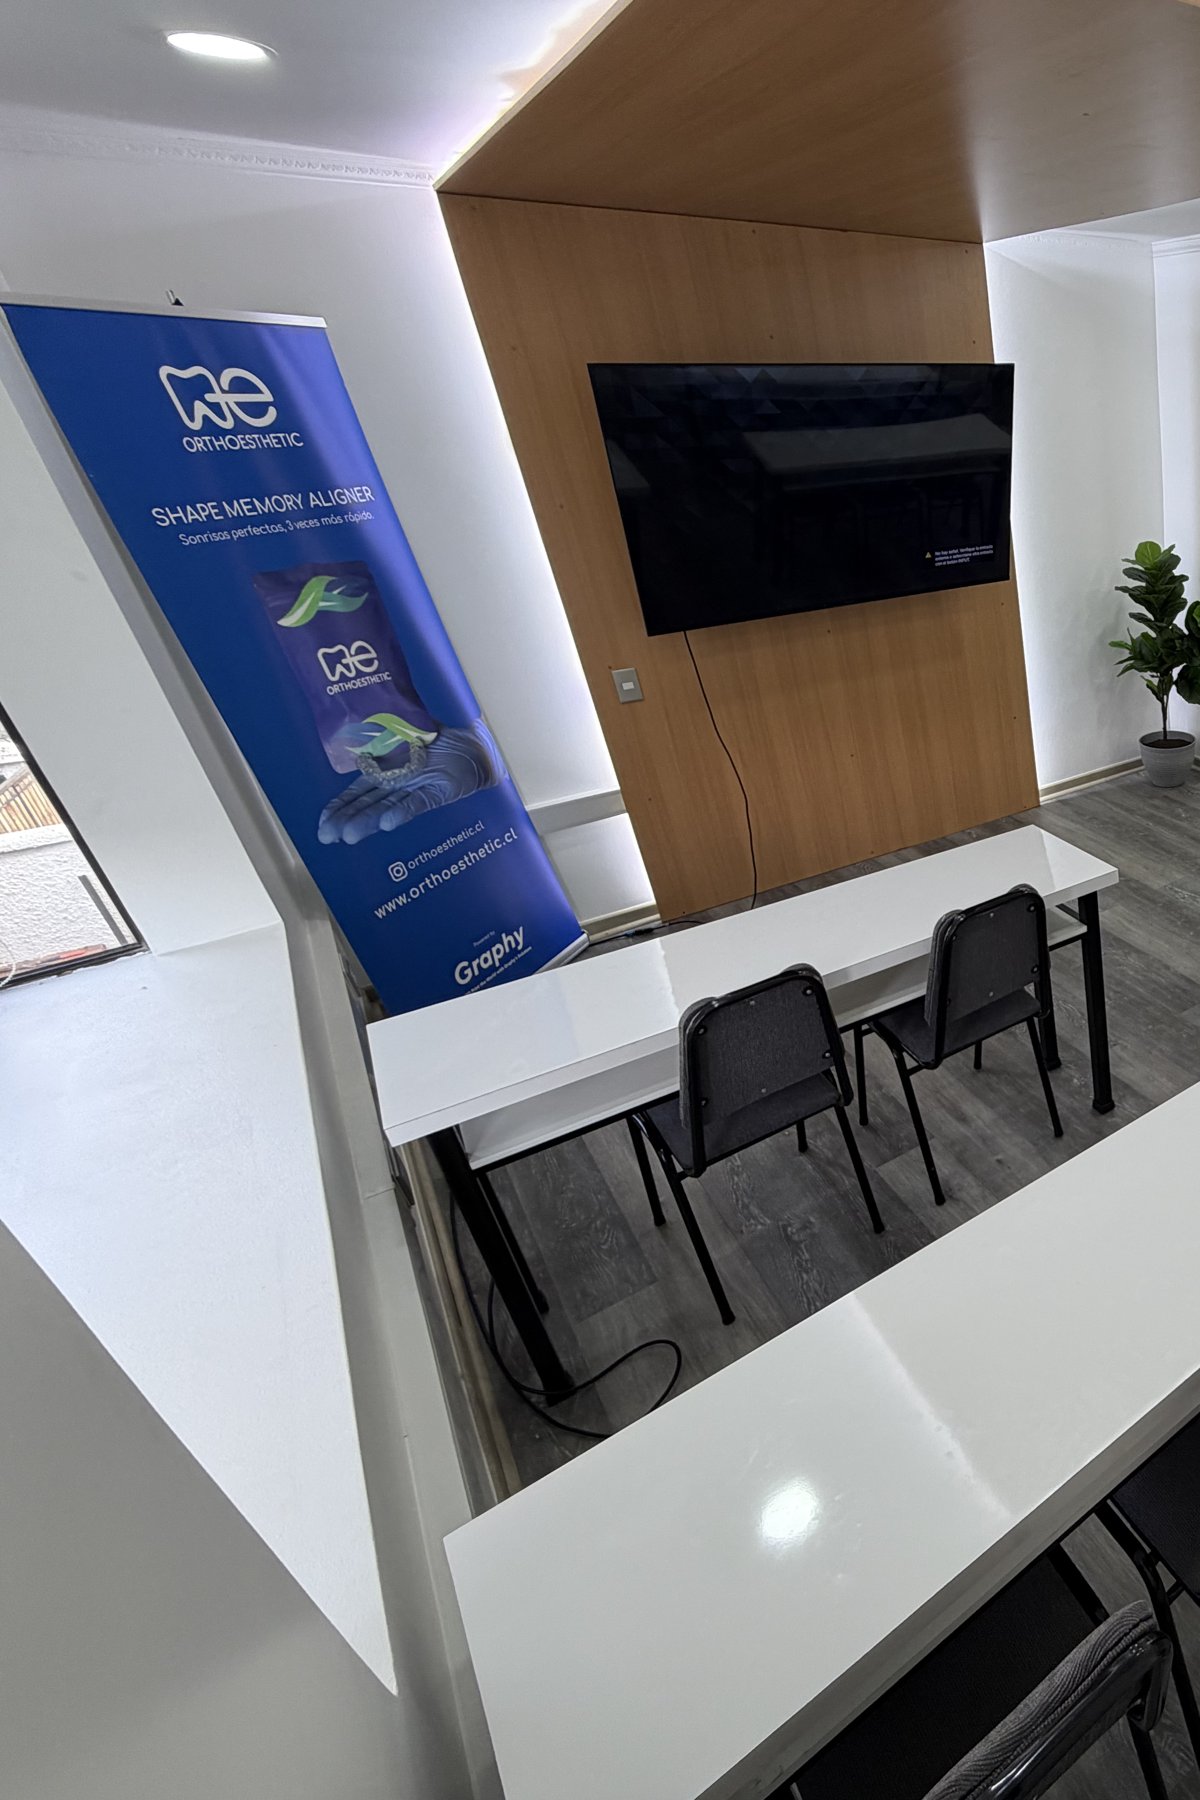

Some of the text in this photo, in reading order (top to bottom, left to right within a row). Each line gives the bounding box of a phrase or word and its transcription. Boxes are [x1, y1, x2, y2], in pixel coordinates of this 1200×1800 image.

[182, 432, 304, 453] ORTHOESTHETIC
[151, 485, 375, 527] SHAPE MEMORY ALIGNER
[178, 531, 231, 547] Sonrisas
[231, 523, 287, 541] perfectas,
[286, 520, 294, 531] 3
[293, 519, 320, 530] veces
[321, 515, 343, 526] más
[326, 671, 392, 696] ORTHOESTHETIC
[407, 820, 485, 870] orthoesthetic.cl
[374, 827, 518, 920] www.orthoesthetic.cl
[454, 926, 523, 985] Graphy
